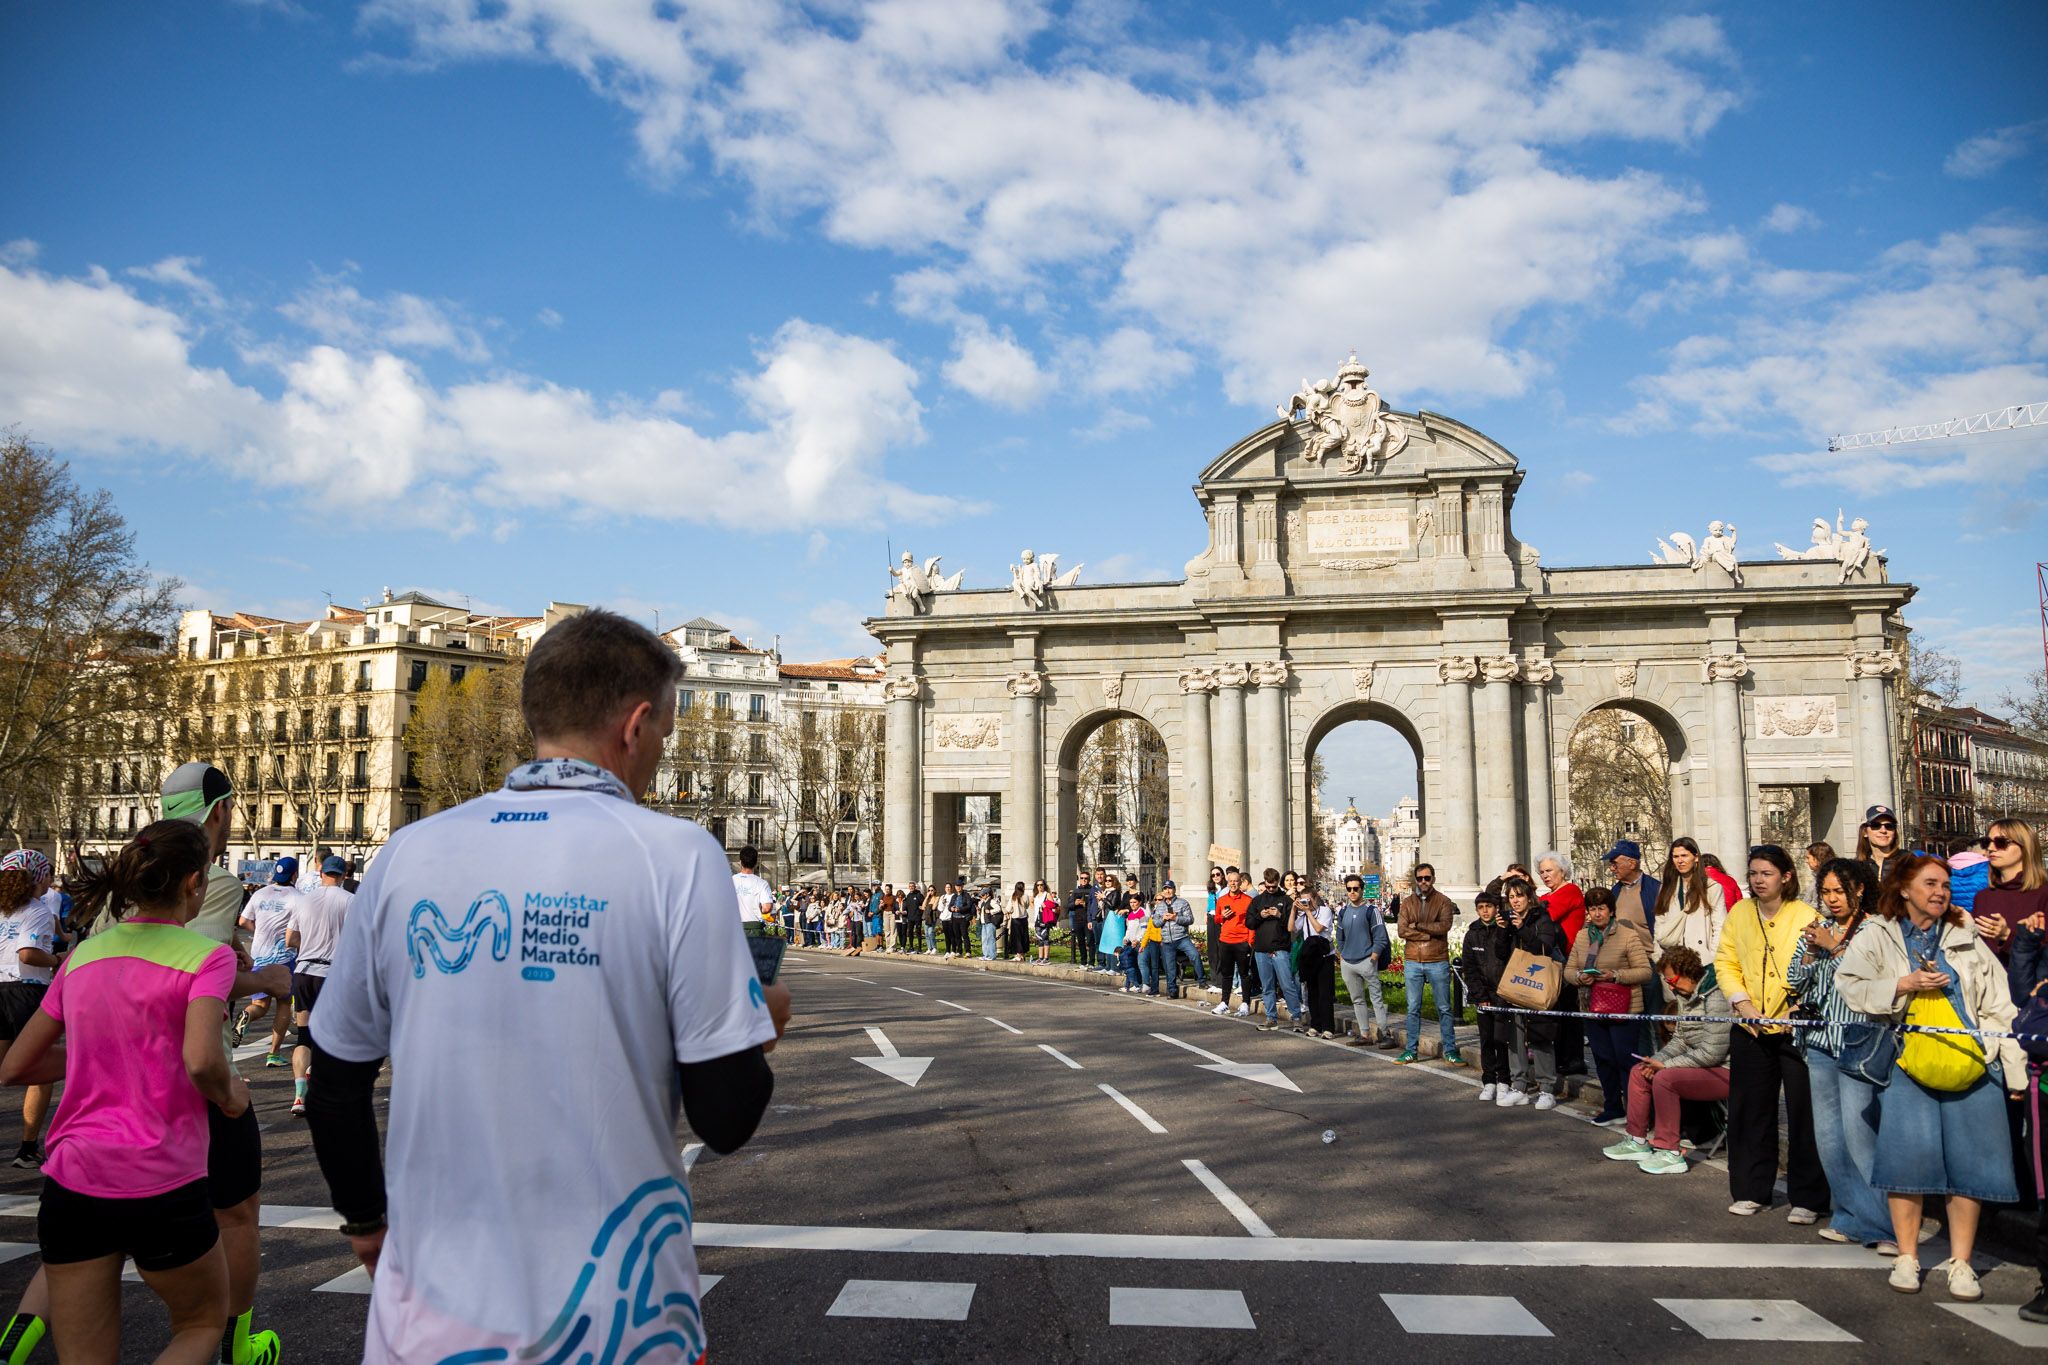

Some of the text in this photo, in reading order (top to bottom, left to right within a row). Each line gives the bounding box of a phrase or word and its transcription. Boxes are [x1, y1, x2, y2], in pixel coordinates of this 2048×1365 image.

[525, 892, 609, 911] Movistar
[523, 909, 590, 928] Madrid
[522, 927, 580, 946] Medio
[521, 945, 601, 966] Maratón
